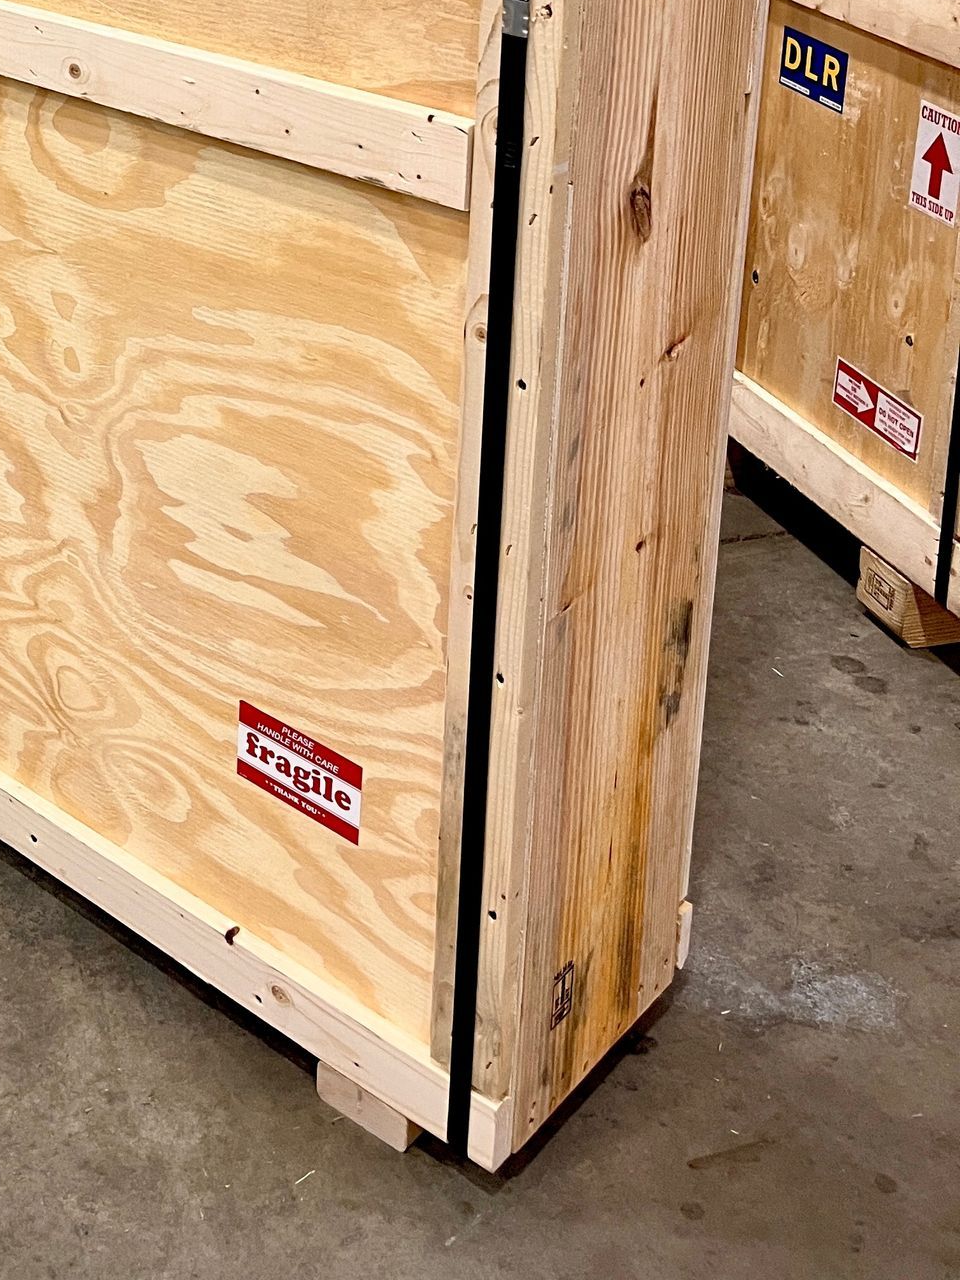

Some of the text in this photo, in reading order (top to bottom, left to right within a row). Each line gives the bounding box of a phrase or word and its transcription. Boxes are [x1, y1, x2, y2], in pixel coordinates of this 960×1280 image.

[784, 36, 840, 91] DLR
[911, 190, 954, 222] THIS SIDE UP
[256, 722, 340, 775] HANDLE WITH CARE
[281, 726, 314, 750] PLEASE
[245, 731, 352, 811] fragile
[273, 784, 317, 815] THANK YOU
